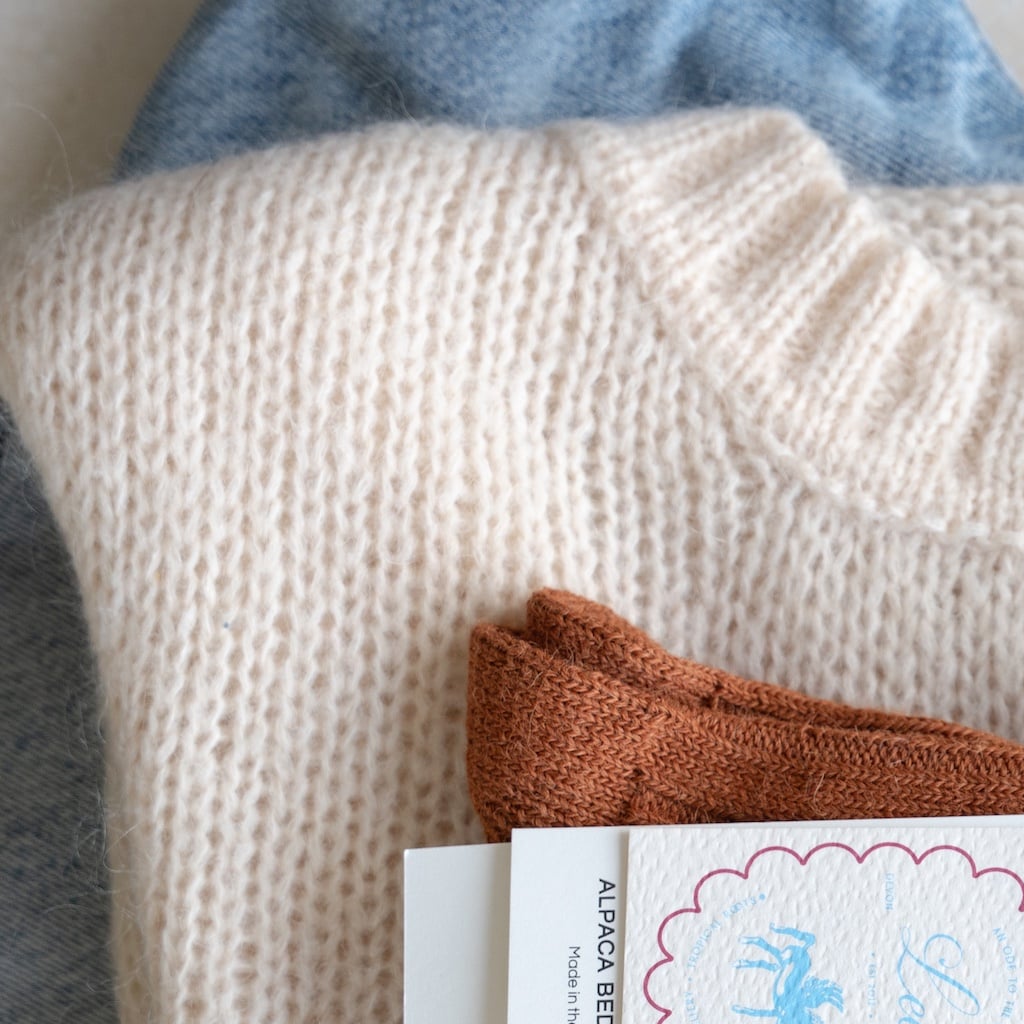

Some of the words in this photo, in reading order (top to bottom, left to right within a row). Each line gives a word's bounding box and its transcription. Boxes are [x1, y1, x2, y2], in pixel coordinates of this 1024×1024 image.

[885, 872, 895, 911] DEVON
[597, 878, 616, 973] ALPACA
[992, 927, 1007, 943] AN
[568, 946, 581, 989] Made
[1002, 944, 1018, 973] ODE
[1007, 975, 1018, 995] TO
[567, 991, 581, 1005] in
[1000, 1000, 1016, 1020] THE
